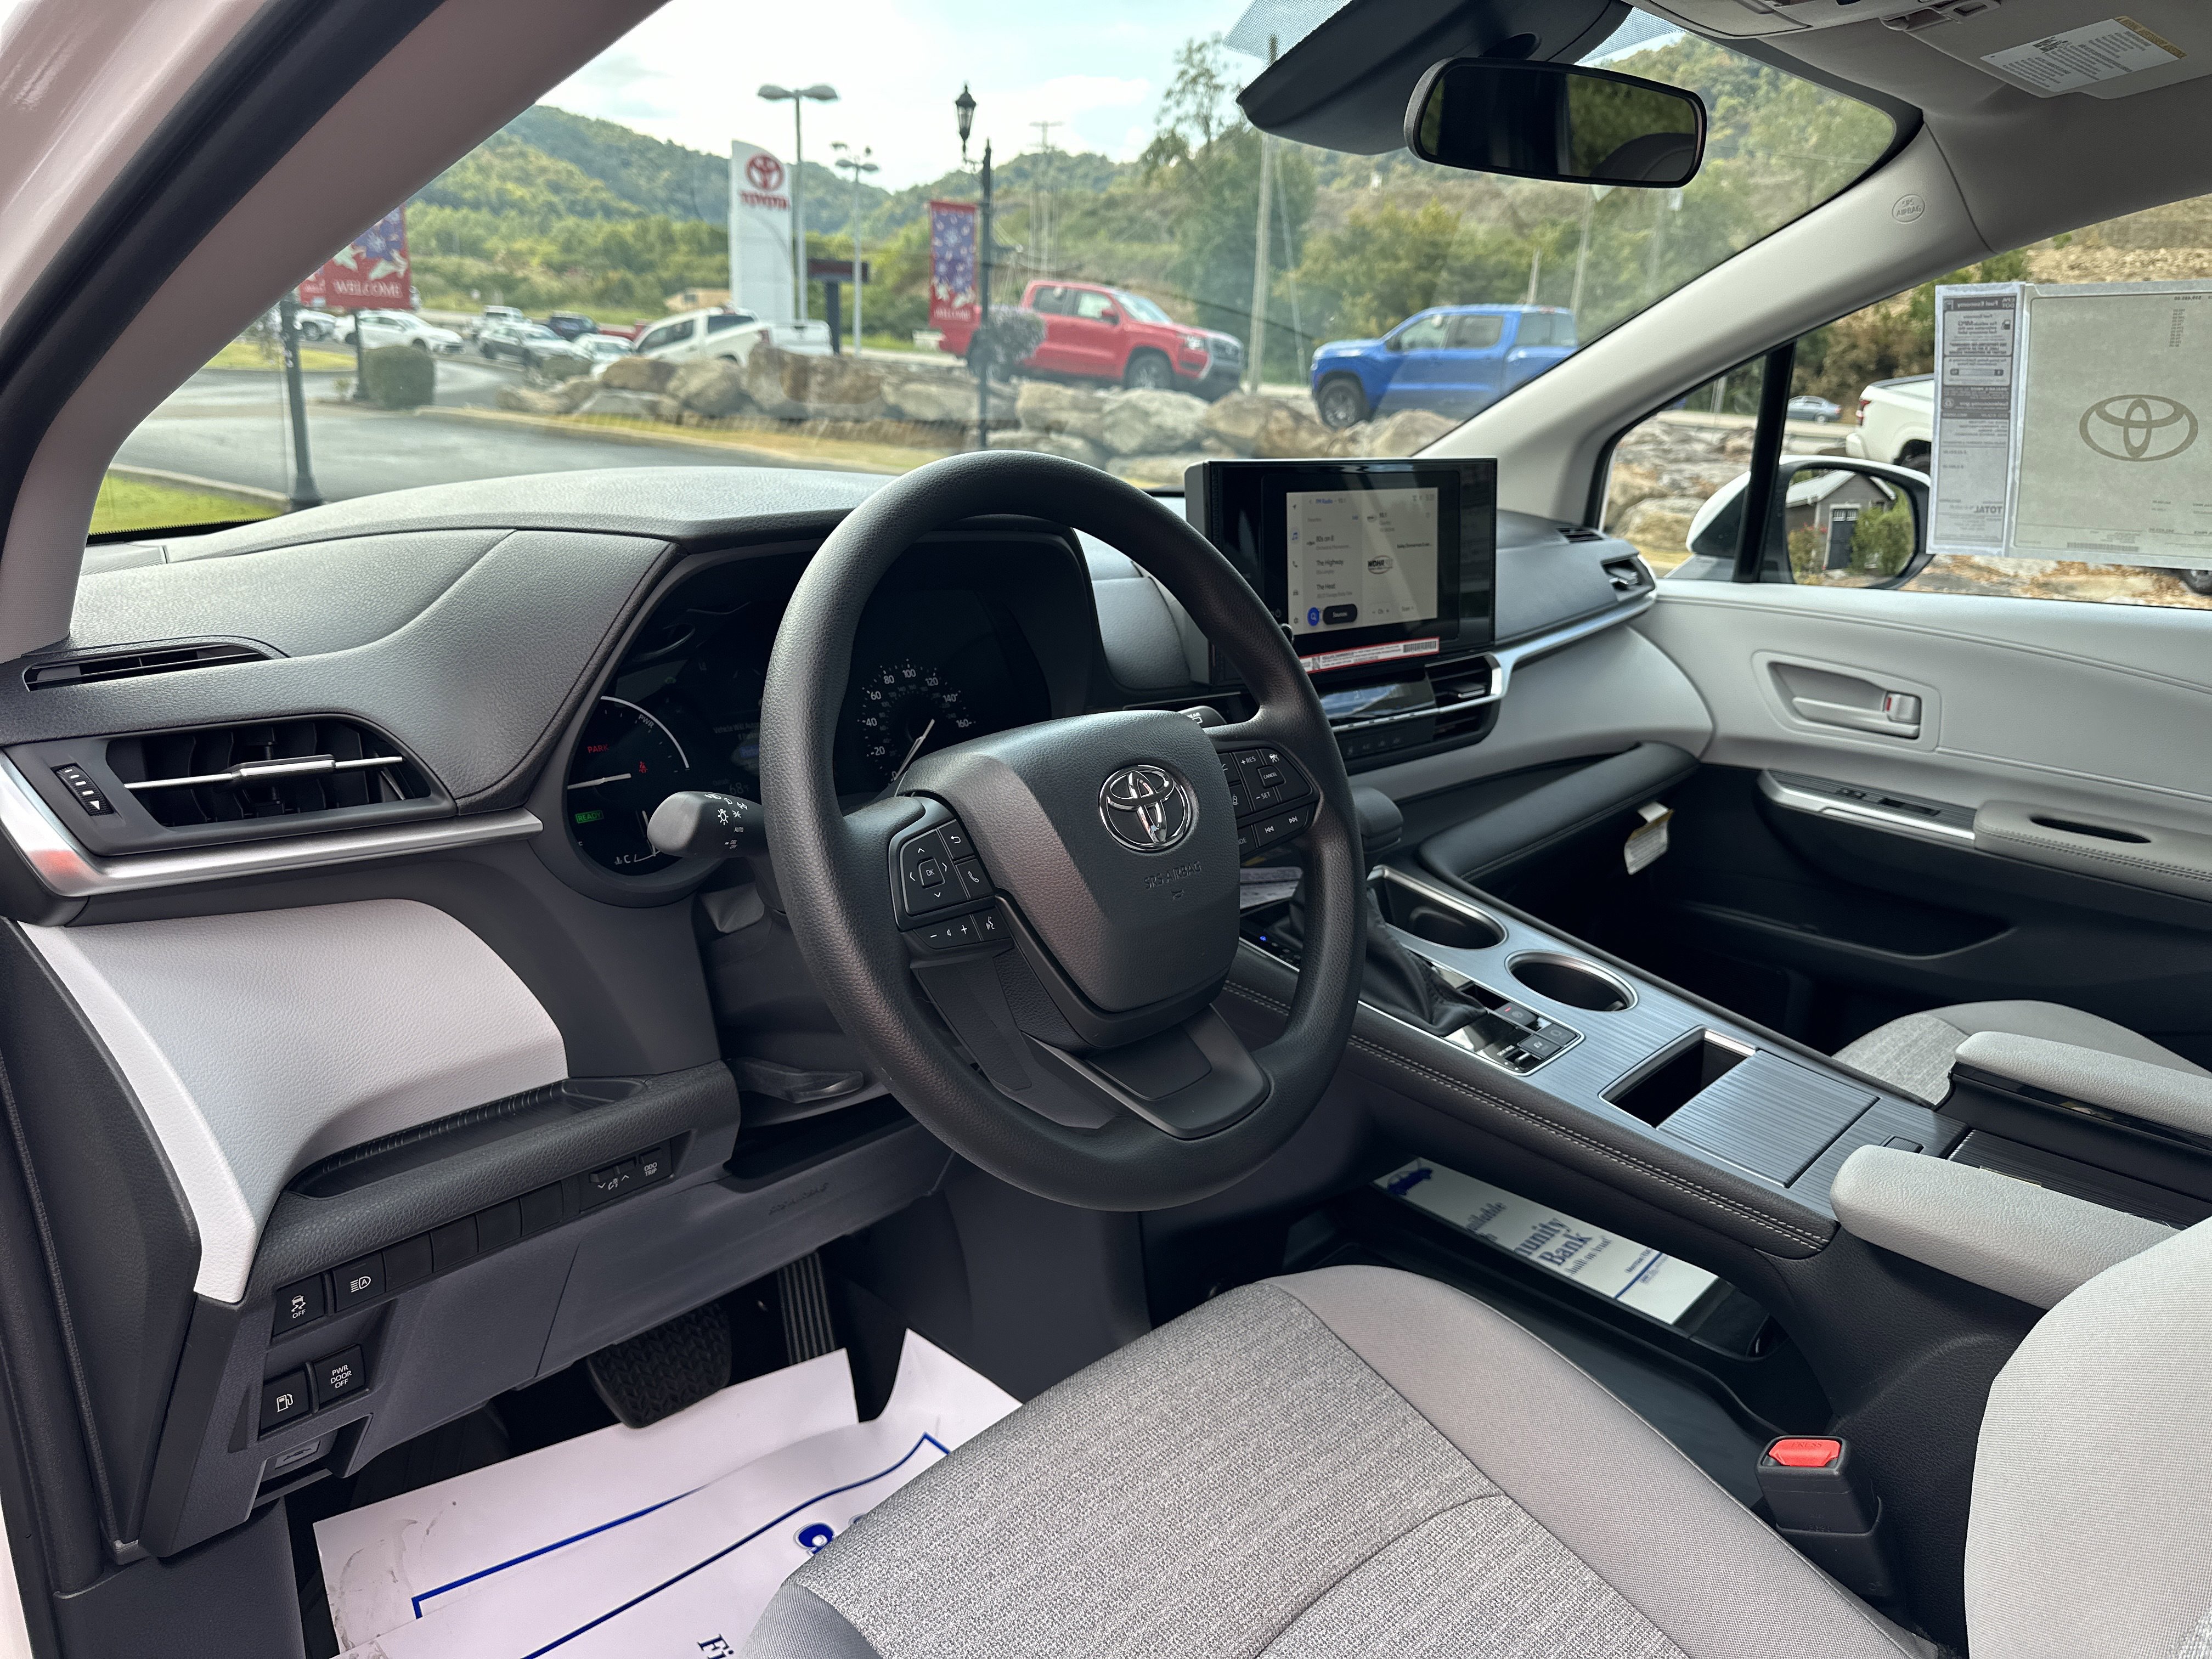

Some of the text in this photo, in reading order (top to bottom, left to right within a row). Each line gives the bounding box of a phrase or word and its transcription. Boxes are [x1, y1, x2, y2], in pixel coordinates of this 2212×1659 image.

[740, 191, 790, 210] TOYOTA
[1896, 205, 1921, 216] AIRBAG
[334, 280, 403, 297] WELCOME
[902, 668, 916, 678] 100
[883, 675, 895, 684] 80
[925, 677, 939, 686] 120
[871, 691, 882, 700] 60
[943, 693, 957, 702] 140
[639, 714, 654, 729] PWR
[866, 717, 877, 726] 40
[956, 718, 969, 728] 160
[588, 744, 608, 753] PARK
[874, 746, 885, 755] 20
[578, 812, 602, 822] READY
[1144, 861, 1202, 889] SRS AIRBAG
[644, 1162, 658, 1171] ODO
[645, 1167, 657, 1177] TRIP
[1538, 1233, 1593, 1266] Bank
[292, 1310, 306, 1319] OFF
[331, 1365, 349, 1376] PWR
[330, 1370, 352, 1384] DOOR
[335, 1379, 349, 1389] OFF
